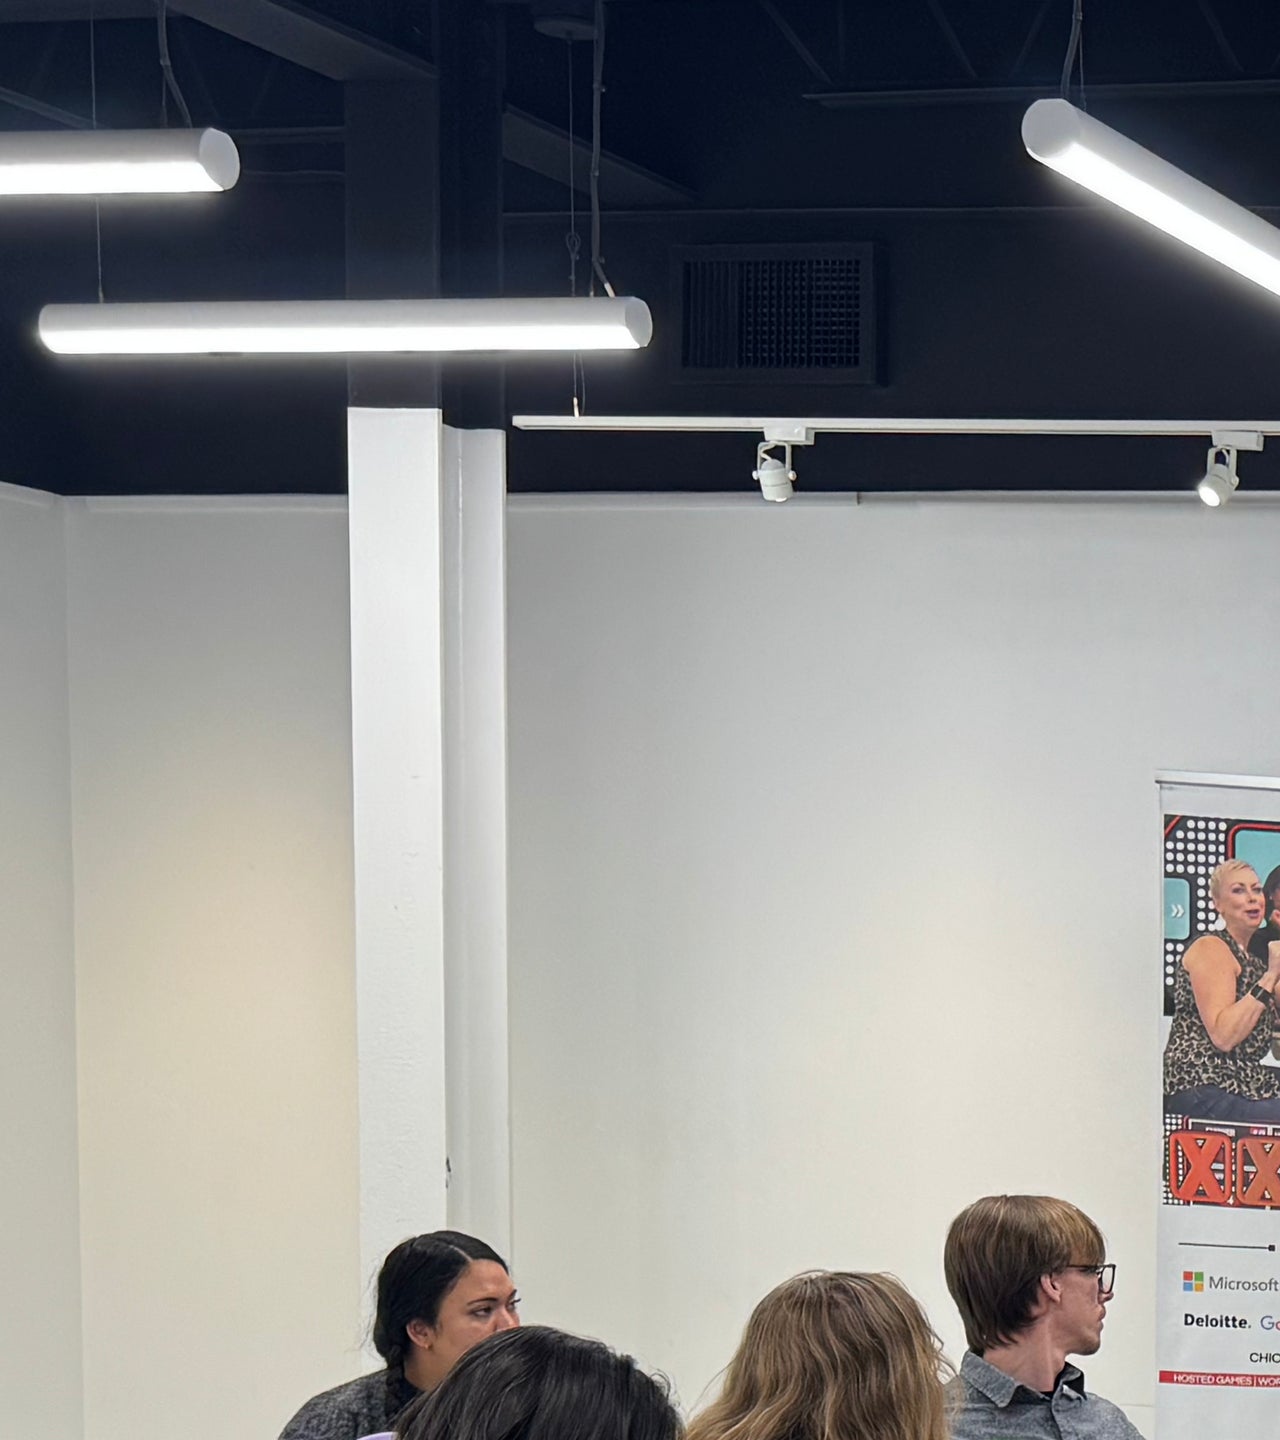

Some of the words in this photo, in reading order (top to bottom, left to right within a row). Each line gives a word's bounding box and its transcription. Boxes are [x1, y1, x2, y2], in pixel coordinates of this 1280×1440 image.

[1208, 1276, 1279, 1292] Microsoft
[1173, 1373, 1215, 1385] HOSTED
[1216, 1376, 1251, 1386] GAMES
